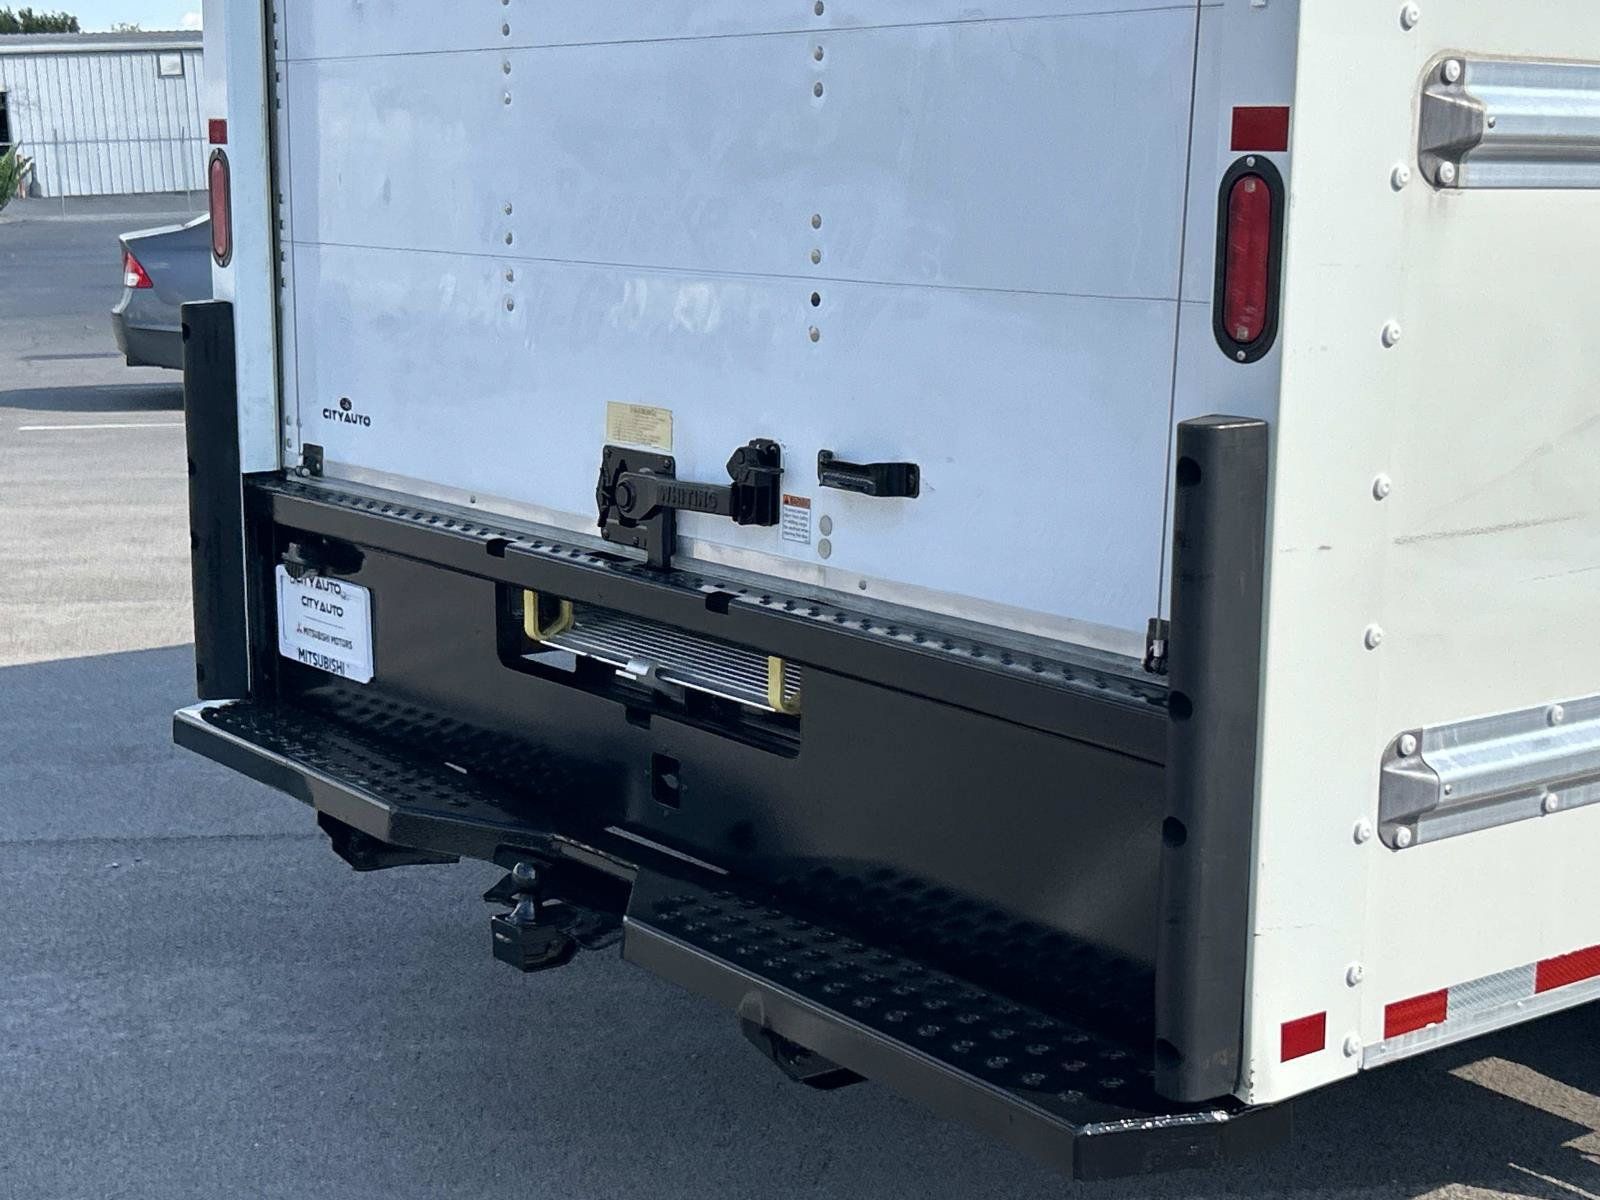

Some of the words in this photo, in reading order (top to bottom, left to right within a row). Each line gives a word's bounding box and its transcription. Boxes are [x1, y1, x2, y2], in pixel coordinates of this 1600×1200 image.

[322, 408, 371, 427] CITYAUTO
[301, 596, 344, 617] CITYAUTO
[303, 626, 330, 643] MITSUBISHI
[331, 636, 353, 650] MOTORS
[298, 647, 345, 675] MITSUBISHI
